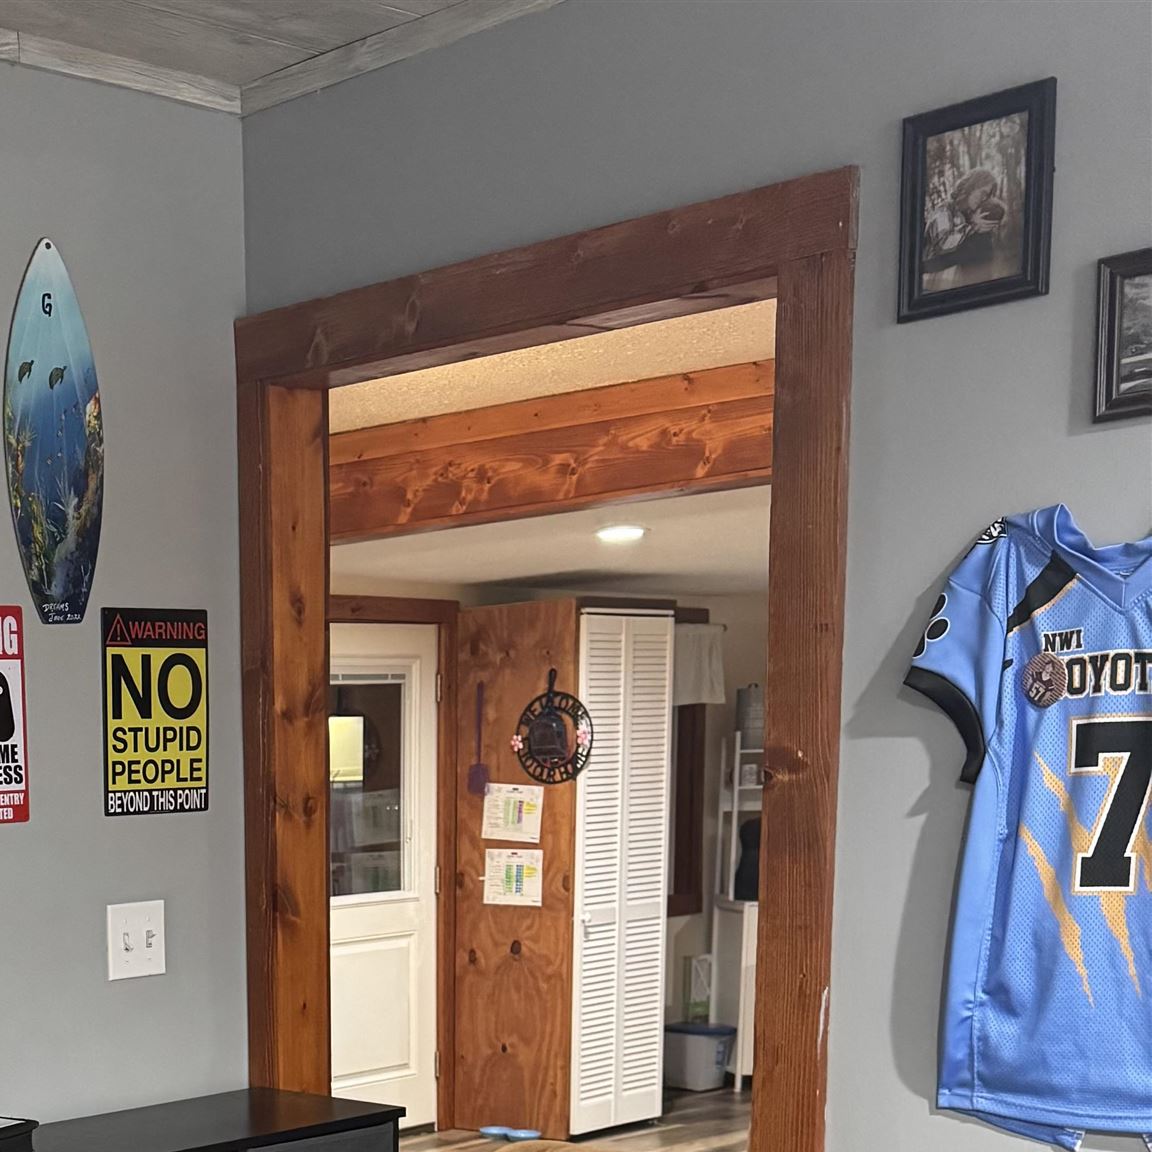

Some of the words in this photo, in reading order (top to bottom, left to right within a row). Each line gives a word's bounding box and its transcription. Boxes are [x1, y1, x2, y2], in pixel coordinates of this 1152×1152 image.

[41, 292, 53, 318] G
[128, 621, 206, 640] WARNING
[1042, 627, 1085, 654] NWI
[110, 652, 203, 720] NO
[1061, 648, 1152, 699] OYOT
[1029, 682, 1046, 701] 57
[111, 725, 202, 754] STUPID
[111, 758, 203, 785] PEOPLE
[0, 792, 25, 806] ENTRY
[108, 791, 151, 813] BEYOND
[151, 789, 175, 811] THIS
[176, 788, 207, 810] POINT
[1070, 713, 1152, 894] 7
